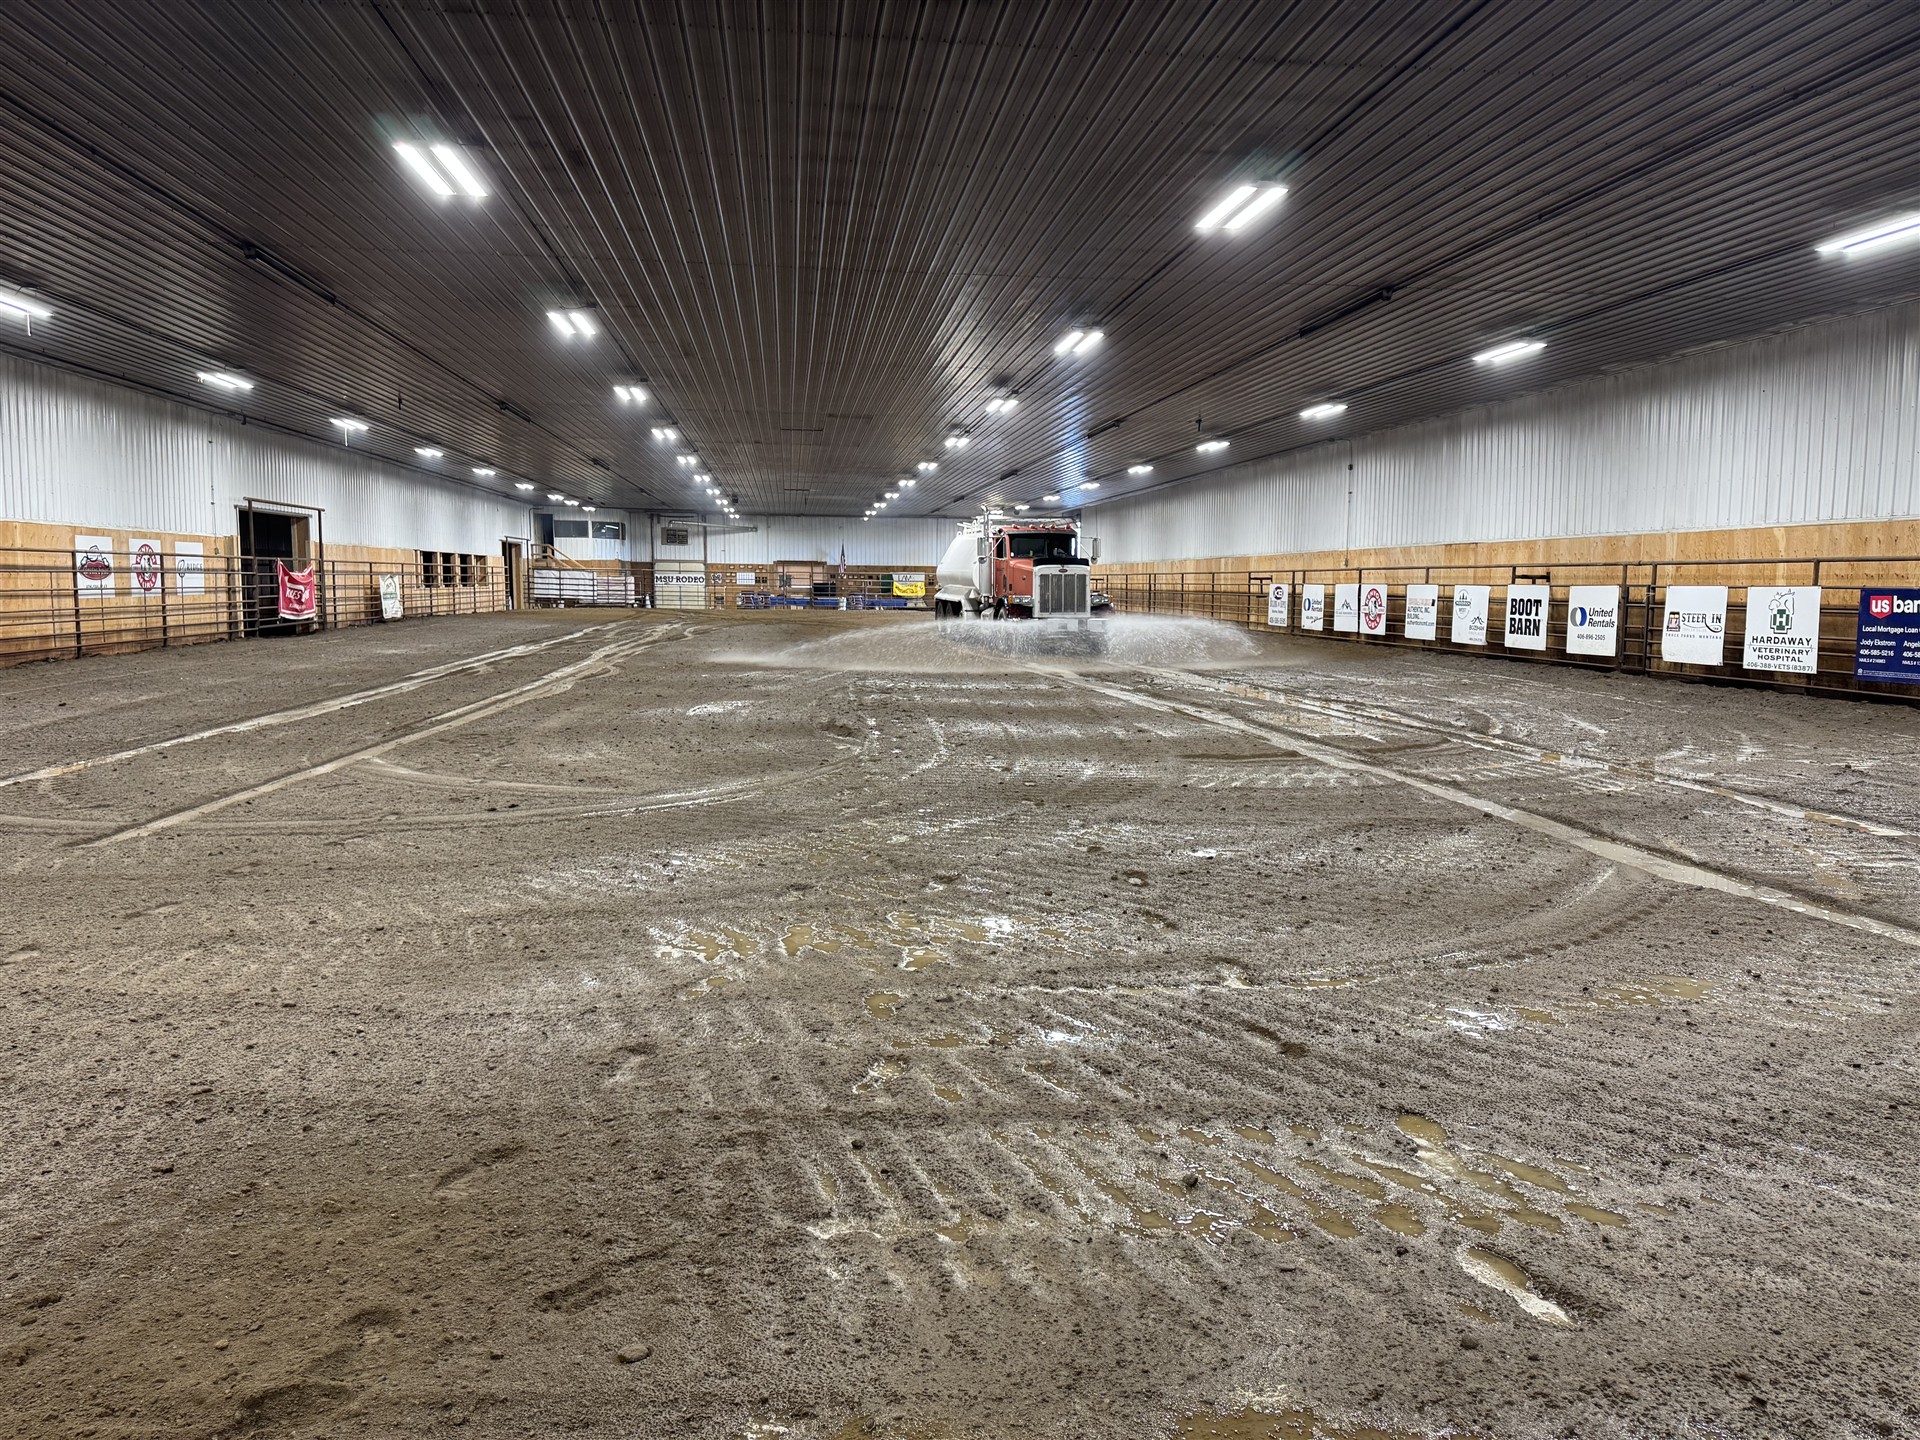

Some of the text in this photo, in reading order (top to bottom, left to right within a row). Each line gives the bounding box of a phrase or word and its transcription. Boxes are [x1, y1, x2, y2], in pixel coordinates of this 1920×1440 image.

[655, 575, 705, 584] MSU RODEO
[1510, 598, 1542, 616] BOOT
[1871, 599, 1890, 613] us
[1588, 607, 1614, 618] United
[1681, 612, 1722, 624] STEER IN
[1508, 617, 1541, 637] BARN
[1587, 618, 1615, 629] Rentals
[1877, 625, 1904, 635] Mortgage
[1904, 626, 1919, 634] Loan
[1751, 635, 1812, 646] HARDAWAY
[1752, 646, 1811, 656] VETERINARY
[1757, 654, 1804, 663] HOSPITAL
